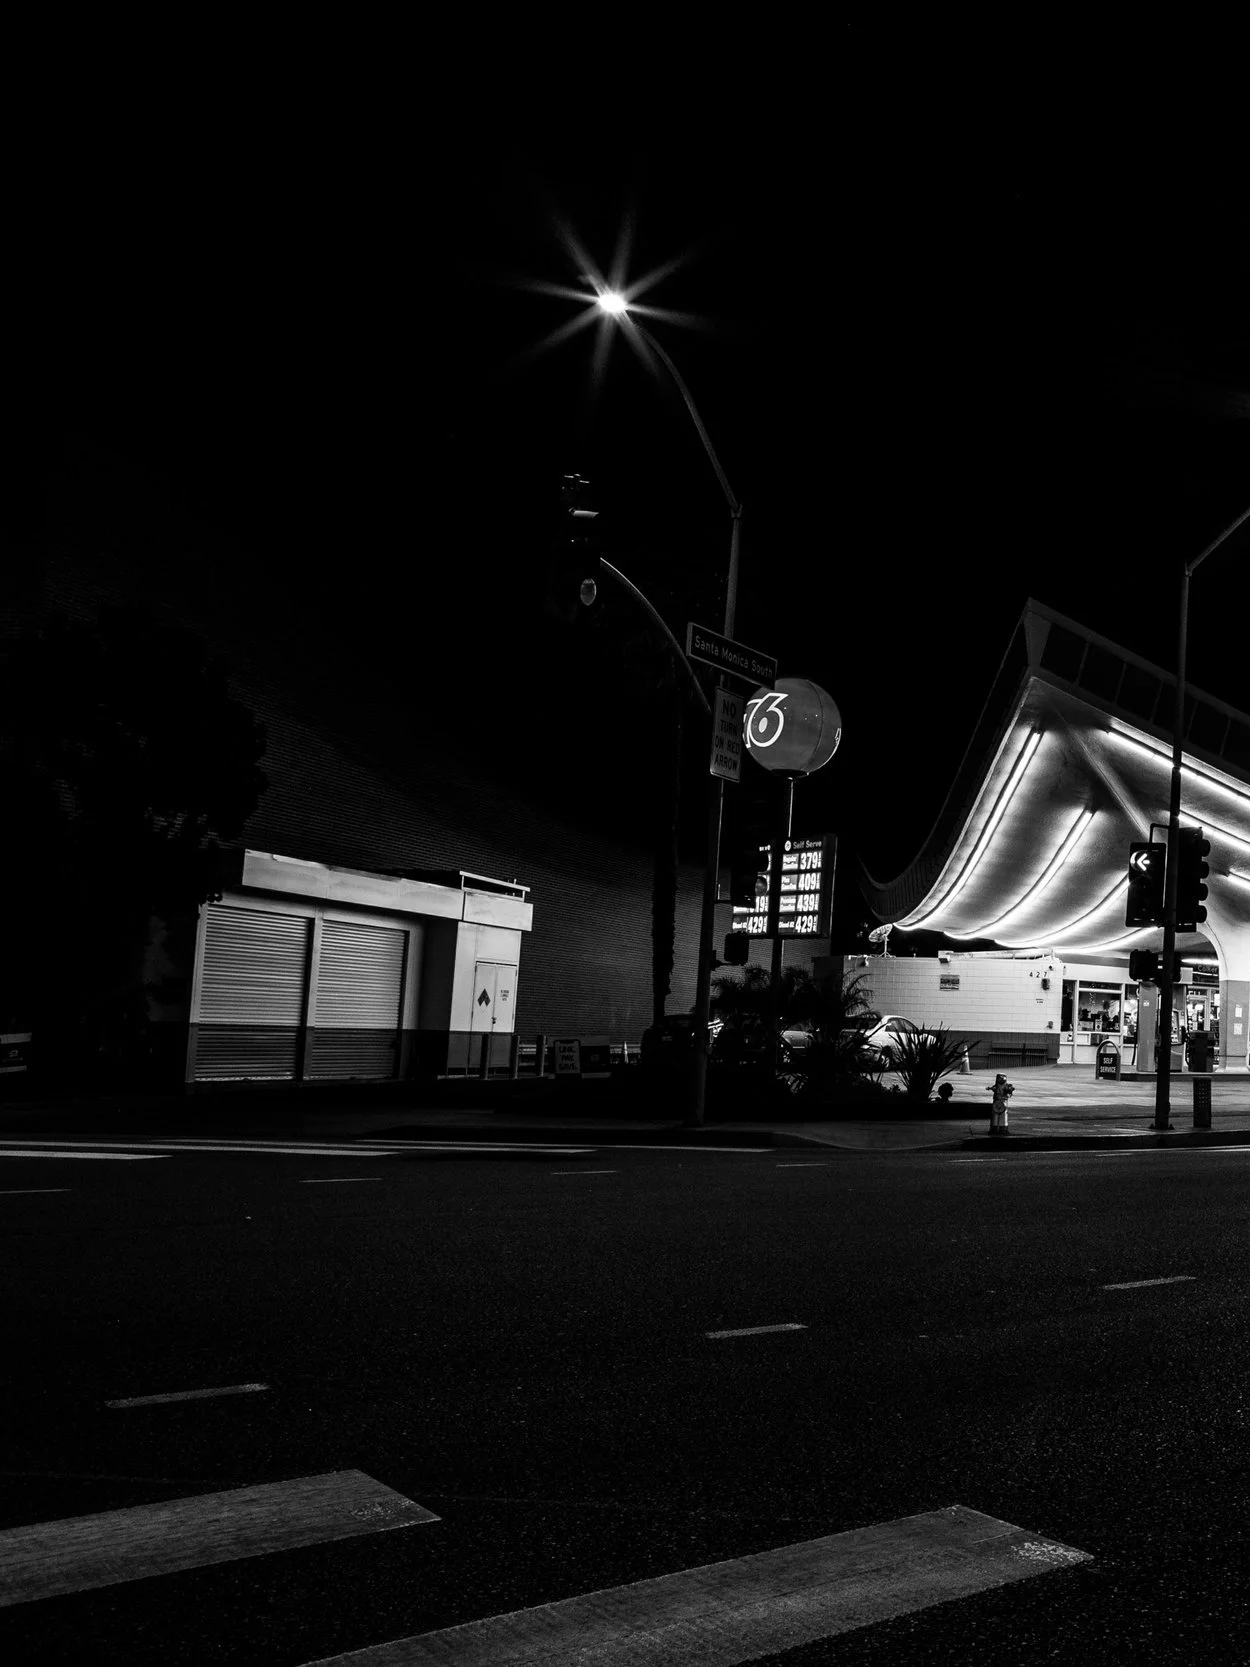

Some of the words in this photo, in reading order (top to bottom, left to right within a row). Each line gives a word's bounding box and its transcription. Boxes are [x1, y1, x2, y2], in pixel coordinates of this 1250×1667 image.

[694, 635, 720, 656] Santa
[720, 646, 749, 669] Monica
[751, 660, 773, 678] South
[722, 700, 737, 717] NO
[720, 719, 738, 736] TURN
[715, 735, 724, 748] ON
[727, 740, 740, 755] RED
[714, 754, 738, 771] ARROW
[793, 841, 805, 850] Self
[806, 840, 822, 849] Serve
